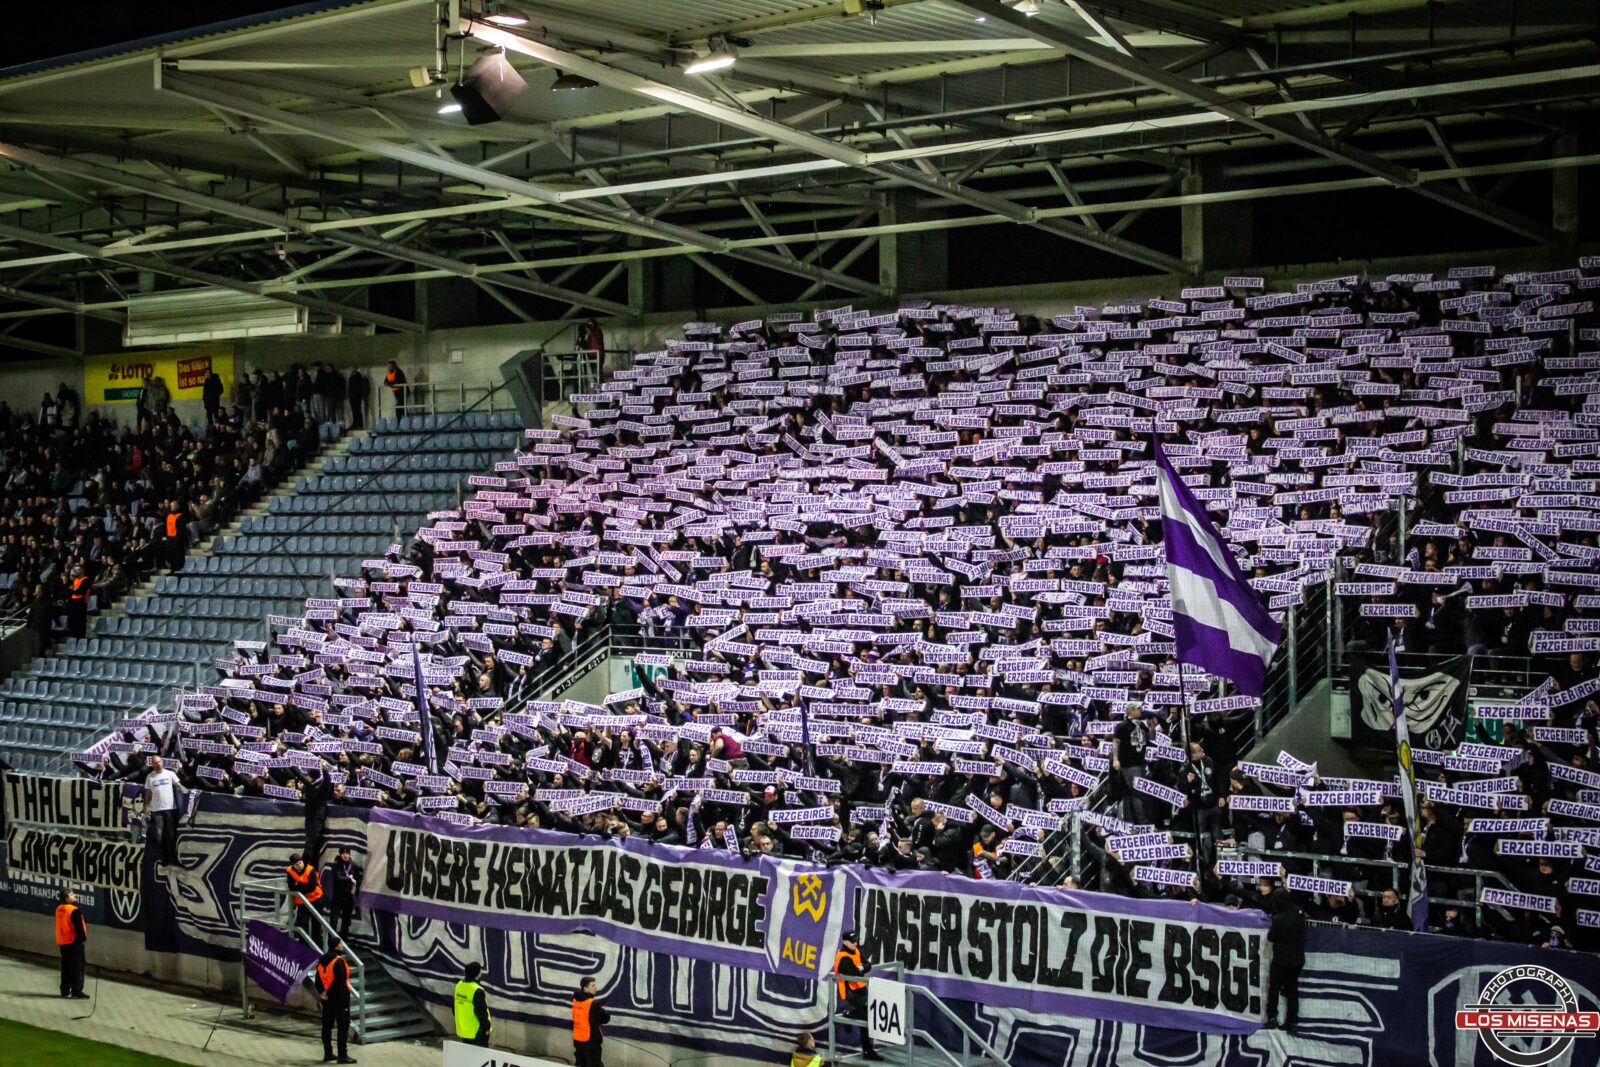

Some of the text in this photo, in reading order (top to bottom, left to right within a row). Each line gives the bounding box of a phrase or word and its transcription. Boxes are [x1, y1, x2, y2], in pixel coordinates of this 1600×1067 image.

[1532, 271, 1578, 282] ERZGEBIRGE
[1183, 289, 1222, 297] ERZGEBIRGE
[1265, 317, 1307, 325] ERZGEBIRGE
[1314, 316, 1360, 325] ERZGEBIRGE
[1444, 321, 1488, 331] ERZGEBIRGE
[121, 363, 153, 379] LOTTO
[1461, 370, 1498, 381] ERZGEBIRGE
[1294, 373, 1338, 383] ERZGEBIRGE
[1355, 385, 1397, 393] ERZGEBIRGE
[1420, 409, 1465, 419] ERZGEBIRGE
[1516, 412, 1565, 420] ERZGEBIRGE
[951, 418, 985, 426] ERZGEBIRGE
[1278, 421, 1323, 429] ERZGEBIRGE
[997, 428, 1037, 436] ERZGEBIRGE
[1076, 431, 1112, 439] ERZGEBIRGE
[1544, 430, 1596, 438] ERZGEBIRGE
[1304, 455, 1352, 466] ERZGEBIRGE
[1045, 463, 1081, 472] ERZGEBIRGE
[1087, 477, 1129, 486] ERZGEBIRGE
[1539, 482, 1591, 490] ERZGEBIRGE
[1235, 483, 1272, 494] ERZGEBIRGE
[1450, 491, 1502, 501] ERZGEBIRGE
[1521, 496, 1573, 506] ERZGEBIRGE
[1055, 523, 1101, 531] ERZGEBIRGE
[1413, 526, 1455, 534] ERZGEBIRGE
[520, 536, 550, 544] ERZGEBIRGE
[1293, 540, 1338, 549] ERZGEBIRGE
[766, 547, 802, 555] ERZGEBIRGE
[1115, 550, 1155, 559] ERZGEBIRGE
[1476, 549, 1528, 559] ERZGEBIRGE
[912, 574, 950, 583] ERZGEBIRGE
[1403, 573, 1455, 583] ERZGEBIRGE
[1013, 581, 1055, 590] ERZGEBIRGE
[1339, 584, 1392, 594] ERZGEBIRGE
[1469, 595, 1525, 607] ERZGEBIRGE
[552, 603, 586, 615] ERZGEBIRGE
[796, 602, 839, 612] ERZGEBIRGE
[1364, 606, 1414, 615] ERZGEBIRGE
[973, 614, 1014, 626] ERZGEBIRGE
[950, 634, 982, 642] ERZGEBIRGE
[808, 642, 849, 652] ERZGEBIRGE
[1536, 640, 1597, 650] ERZGEBIRGE
[637, 655, 670, 664] ERZGEBIRGE
[686, 662, 725, 672] ERZGEBIRGE
[762, 672, 798, 680] ERZGEBIRGE
[916, 675, 960, 685] ERZGEBIRGE
[1008, 672, 1050, 681] ERZGEBIRGE
[255, 690, 285, 702] ERZGEBIRGE
[1082, 689, 1125, 699] ERZGEBIRGE
[528, 703, 561, 711] ERZGEBIRGE
[720, 702, 759, 711] ERZGEBIRGE
[1194, 696, 1258, 712] ERZGEBIRGE
[1478, 707, 1546, 718] ERZGEBIRGE
[150, 714, 178, 723] ERZGEBIRGE
[592, 716, 641, 724] ERZGEBIRGE
[191, 724, 224, 732] ERZGEBIRGE
[809, 724, 849, 735] ERZGEBIRGE
[681, 729, 708, 741] ERZGEBIRGE
[1536, 729, 1584, 742] ERZGEBIRGE
[343, 742, 378, 752] ERZGEBIRGE
[479, 753, 508, 764] ERZGEBIRGE
[848, 751, 896, 762] ERZGEBIRGE
[994, 747, 1035, 770] ERZGEBIRGE
[236, 764, 264, 774] ERZGEBIRGE
[394, 764, 423, 774] ERZGEBIRGE
[530, 760, 564, 772] ERZGEBIRGE
[895, 762, 942, 773] ERZGEBIRGE
[1446, 758, 1498, 772] ERZGEBIRGE
[614, 770, 651, 781] ERZGEBIRGE
[735, 772, 776, 782] ERZGEBIRGE
[1046, 760, 1095, 787] ERZGEBIRGE
[487, 783, 523, 792] ERZGEBIRGE
[796, 778, 838, 791] ERZGEBIRGE
[265, 786, 296, 798] ERZGEBIRGE
[345, 789, 379, 799] ERZGEBIRGE
[704, 791, 744, 802] ERZGEBIRGE
[1137, 780, 1183, 806] ERZGEBIRGE
[422, 798, 455, 807] RZGEBIRGE
[1309, 792, 1376, 804] ERZGEBIRGE
[1430, 787, 1493, 808] ERZGEBIRGE
[572, 798, 615, 815] ERZGEBIRGE
[1232, 797, 1290, 810] ERZGEBIRGE
[773, 809, 830, 821] ERZGEBIRGE
[1026, 816, 1060, 829] ERZGEBIRGE
[1473, 820, 1544, 831] ERZGEBIRGE
[793, 827, 837, 839] ERZGEBIRGE
[1348, 824, 1398, 839] ERZGEBIRGE
[1110, 833, 1168, 850] ERZGEBIRGE
[1005, 842, 1041, 855] ERZGEBIRGE
[1122, 845, 1185, 860] ERZGEBIRGE
[1502, 842, 1578, 856] ERZGEBIRGE
[8, 827, 144, 890] LANGENBACH
[1219, 862, 1277, 874] ERZGEBIRGE
[1137, 868, 1193, 885] ERZGEBIRGE
[13, 884, 28, 895] UND
[386, 830, 770, 949] UNSERE HEIMAT DAS GEBIRGE
[1289, 877, 1347, 894] ERZGEBIRGE
[1484, 890, 1552, 910] ERZGEBIRGE
[782, 936, 818, 969] AUE
[854, 887, 963, 974] UNSER
[967, 899, 1087, 989] STOLZ
[1090, 916, 1155, 998] DIE
[1158, 924, 1261, 1015] BSG!
[870, 999, 902, 1035] 19A
